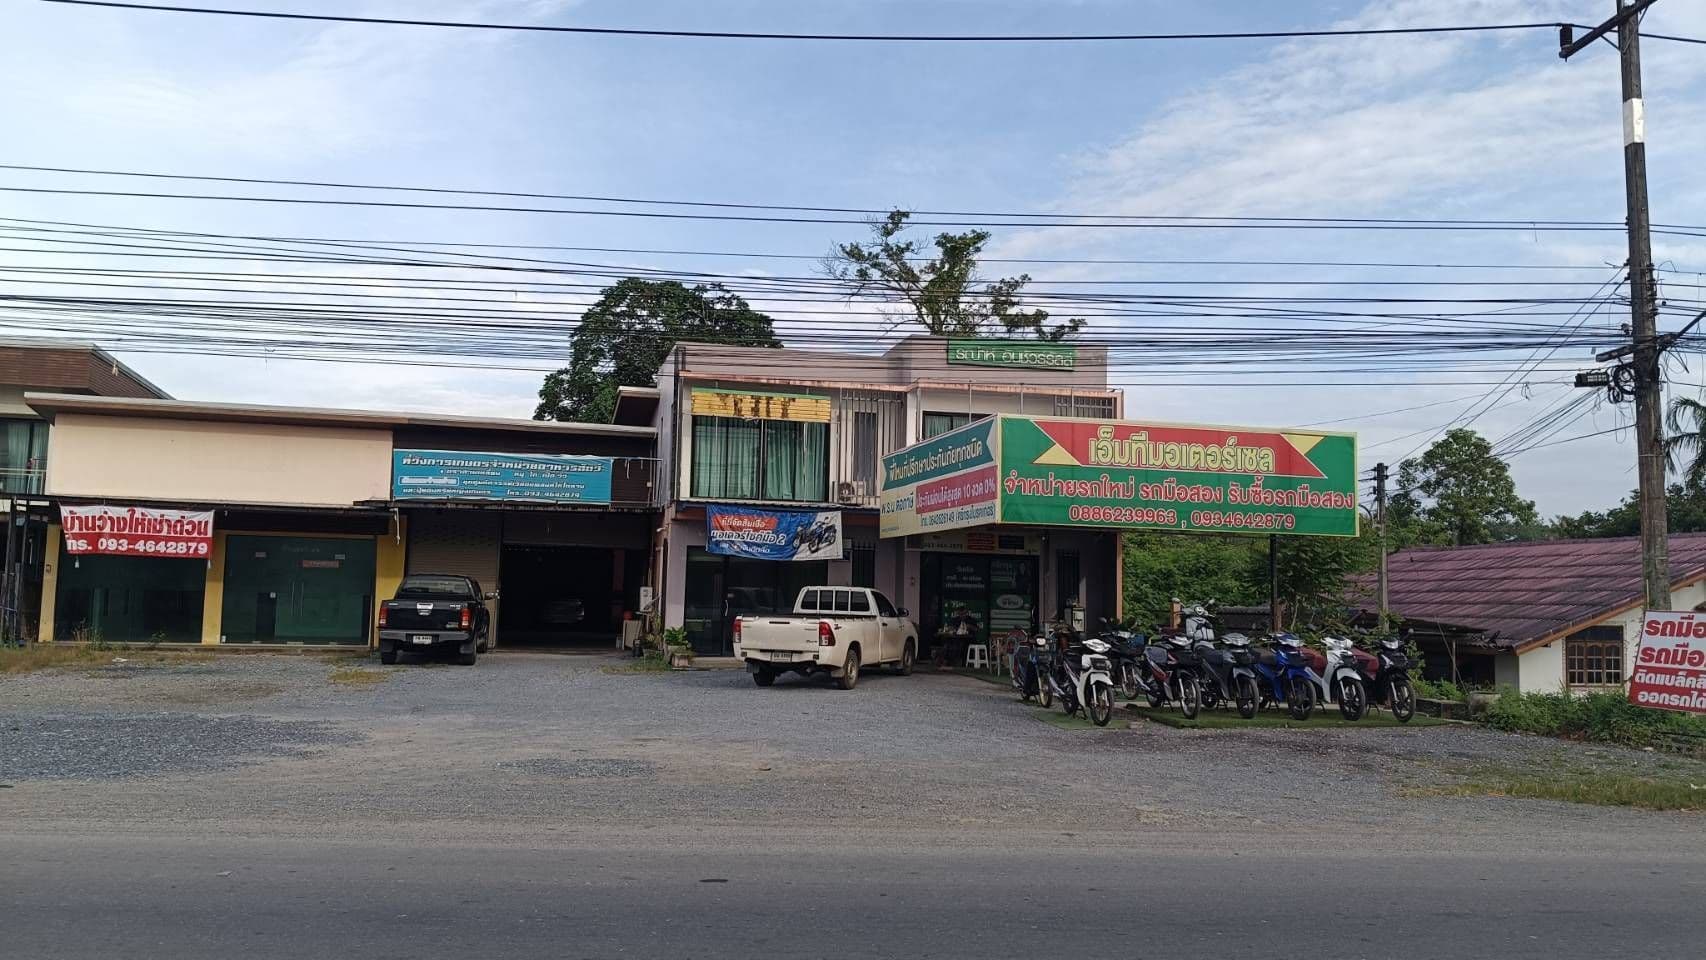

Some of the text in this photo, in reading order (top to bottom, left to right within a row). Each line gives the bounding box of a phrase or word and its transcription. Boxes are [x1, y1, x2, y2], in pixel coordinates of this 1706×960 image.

[1088, 425, 1275, 472] เอ็มทีมอเตอร์เซล
[1004, 470, 1354, 509] จำหน่ายรถใหม่ รถมือสอง รับซื้อรถมือสอง
[63, 507, 209, 536] บ้านว่างให้เช่าด่วน
[1069, 504, 1177, 524] 0886239963
[1191, 510, 1295, 529] 0934642879
[98, 538, 208, 554] 093-4642879
[777, 533, 787, 545] 2
